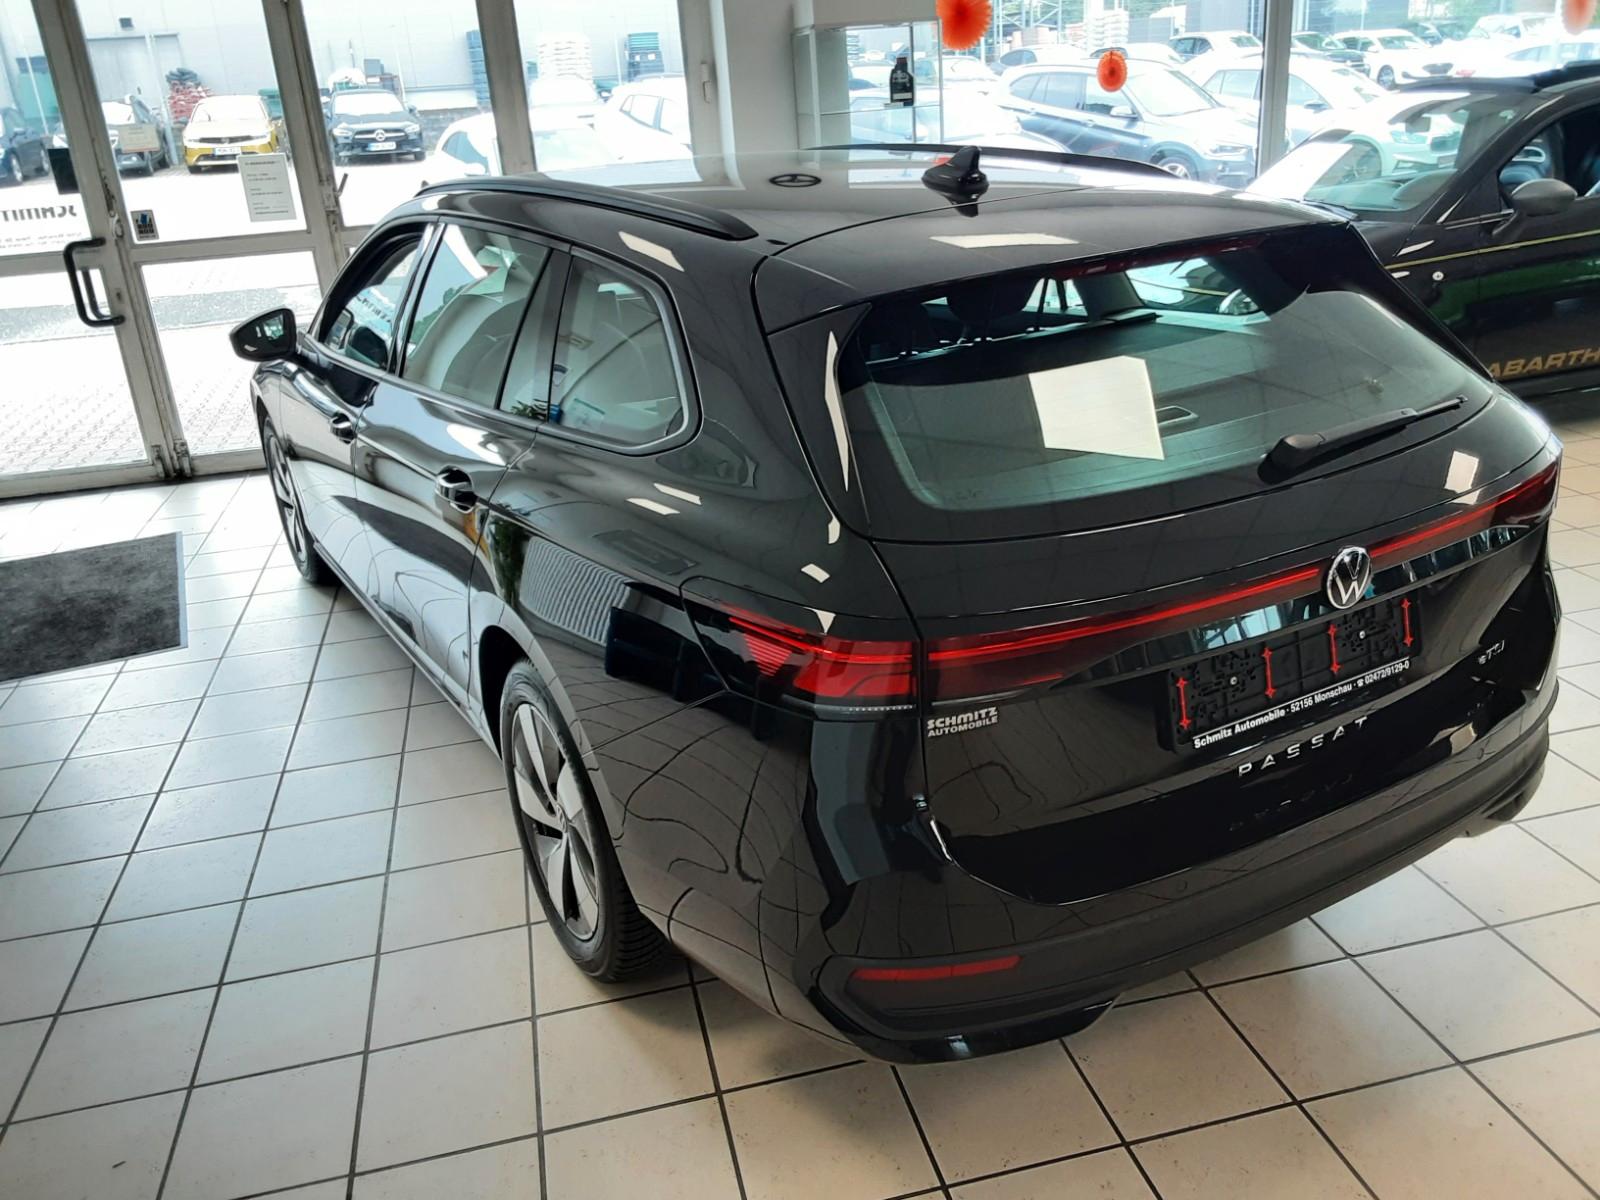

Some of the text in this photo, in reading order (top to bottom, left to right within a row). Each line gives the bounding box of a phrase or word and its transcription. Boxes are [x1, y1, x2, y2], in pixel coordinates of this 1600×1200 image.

[1487, 347, 1600, 378] ABARTH
[927, 706, 998, 730] SCHMITZ
[1193, 660, 1411, 749] Schmitz Automobile 52156 Monschau 02472/9129-0
[927, 716, 998, 738] AUTOMOBILE
[1238, 716, 1368, 777] PASSAT
